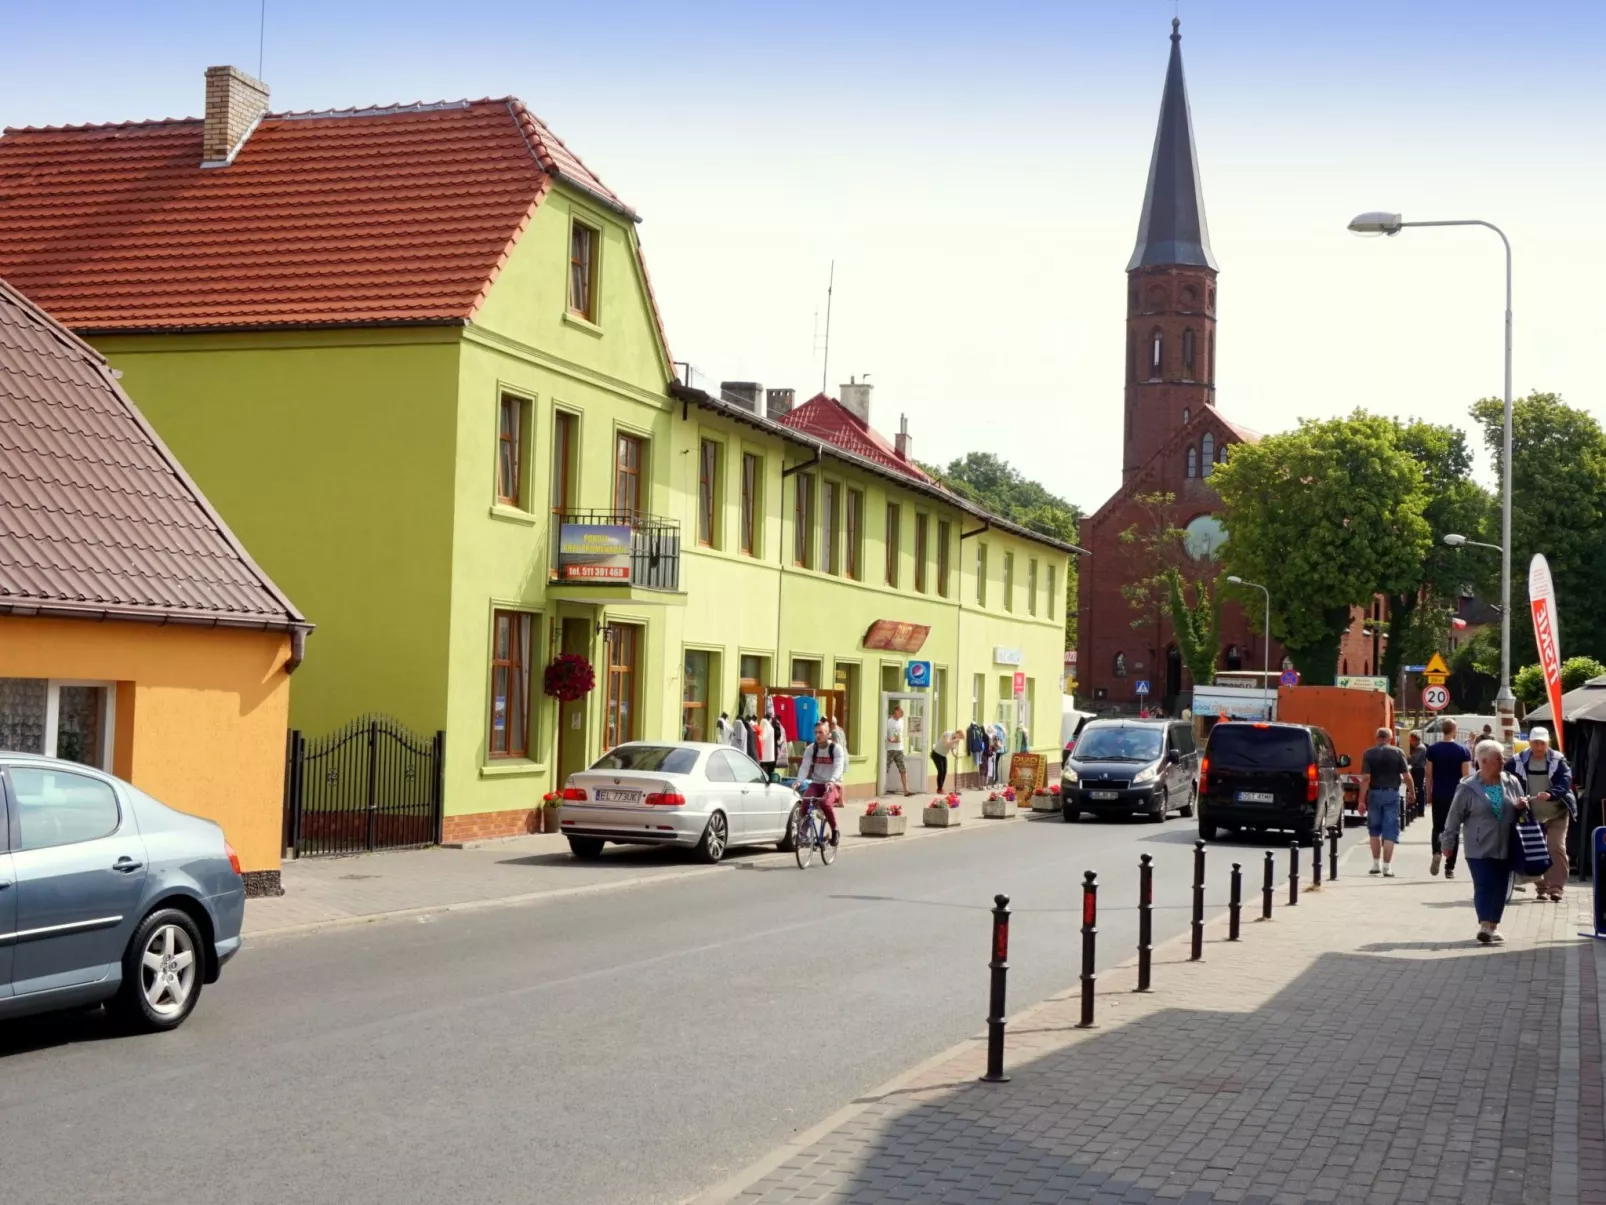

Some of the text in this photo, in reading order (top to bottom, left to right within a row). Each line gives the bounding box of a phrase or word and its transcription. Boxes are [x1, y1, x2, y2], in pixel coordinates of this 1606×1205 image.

[569, 567, 581, 576] tel.
[582, 567, 594, 577] 511
[1428, 690, 1446, 703] 20
